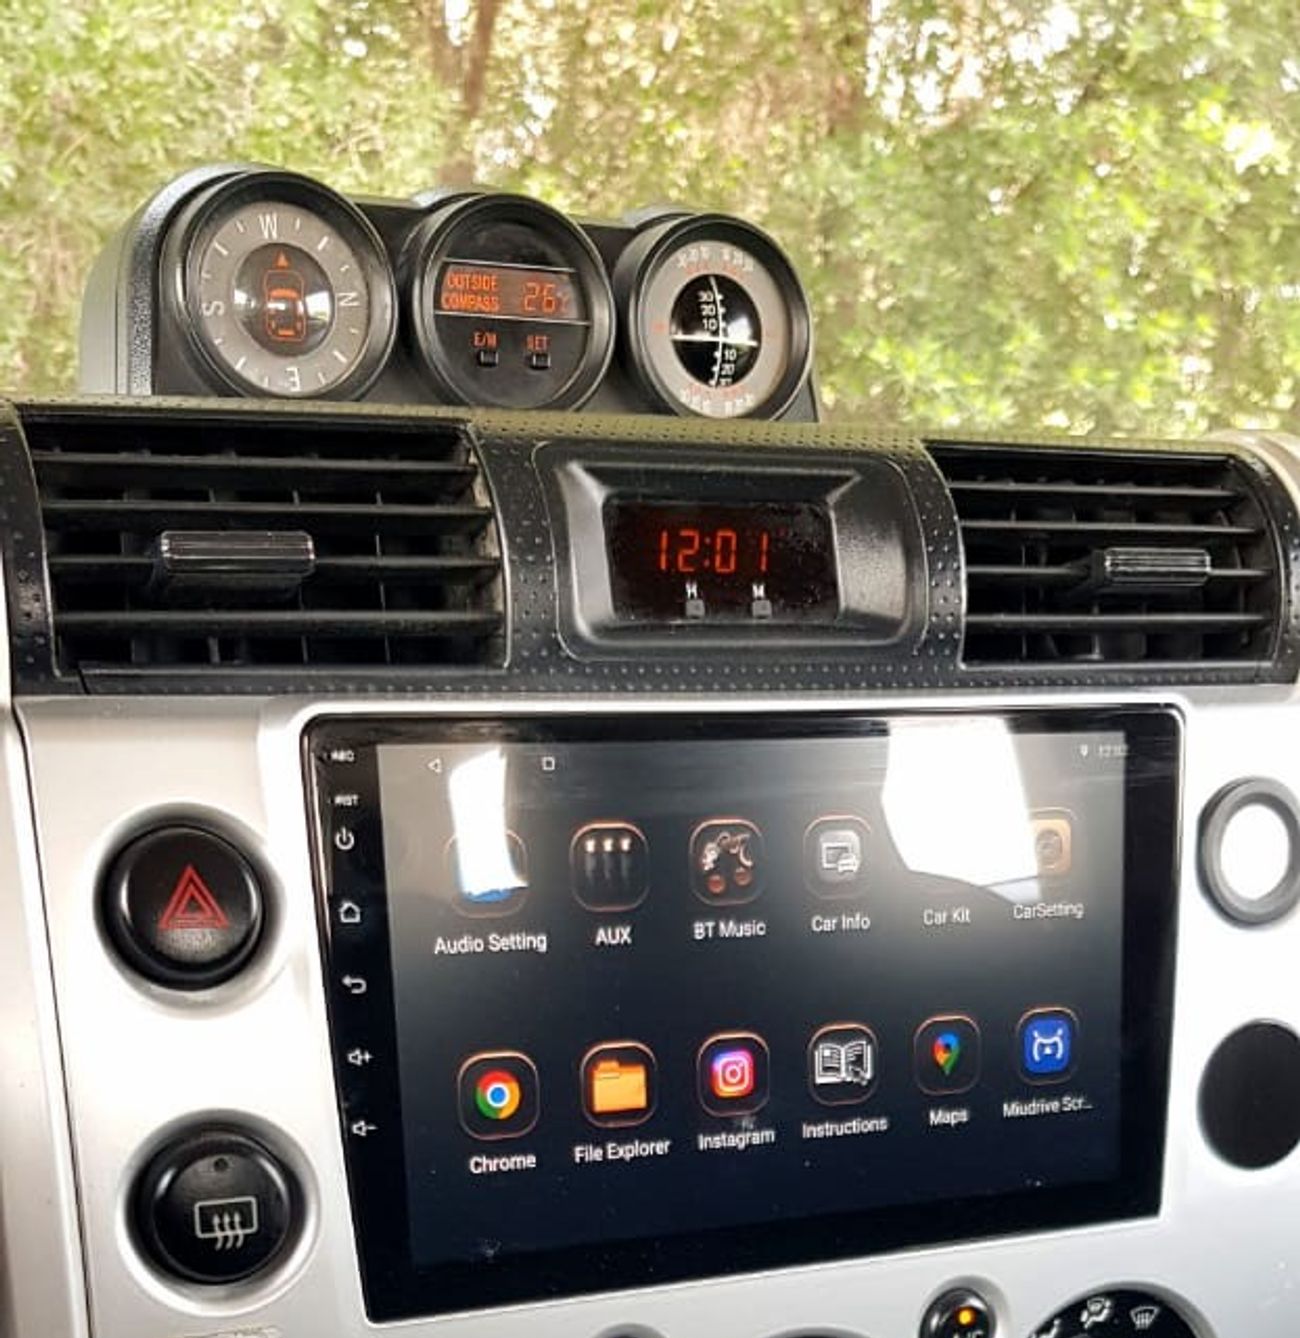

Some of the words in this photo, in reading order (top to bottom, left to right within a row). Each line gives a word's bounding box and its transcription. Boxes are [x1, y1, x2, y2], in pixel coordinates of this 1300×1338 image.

[447, 271, 498, 291] OUTSIDE
[440, 291, 500, 313] COMPASS
[659, 530, 769, 573] 12:01
[923, 908, 949, 927] Car
[952, 907, 971, 925] Kit
[1013, 900, 1084, 920] CarSetting
[693, 921, 715, 940] BT
[719, 919, 767, 939] Music
[811, 914, 838, 933] Car
[841, 912, 871, 932] Info
[434, 935, 484, 955] Audio
[489, 931, 547, 953] Setting
[595, 926, 632, 945] AUX
[929, 1107, 969, 1127] Maps
[802, 1116, 889, 1140] Instructions
[698, 1127, 775, 1151] Instagram
[574, 1145, 603, 1164] File
[607, 1138, 671, 1162] Explorer
[469, 1152, 537, 1175] Chrome
